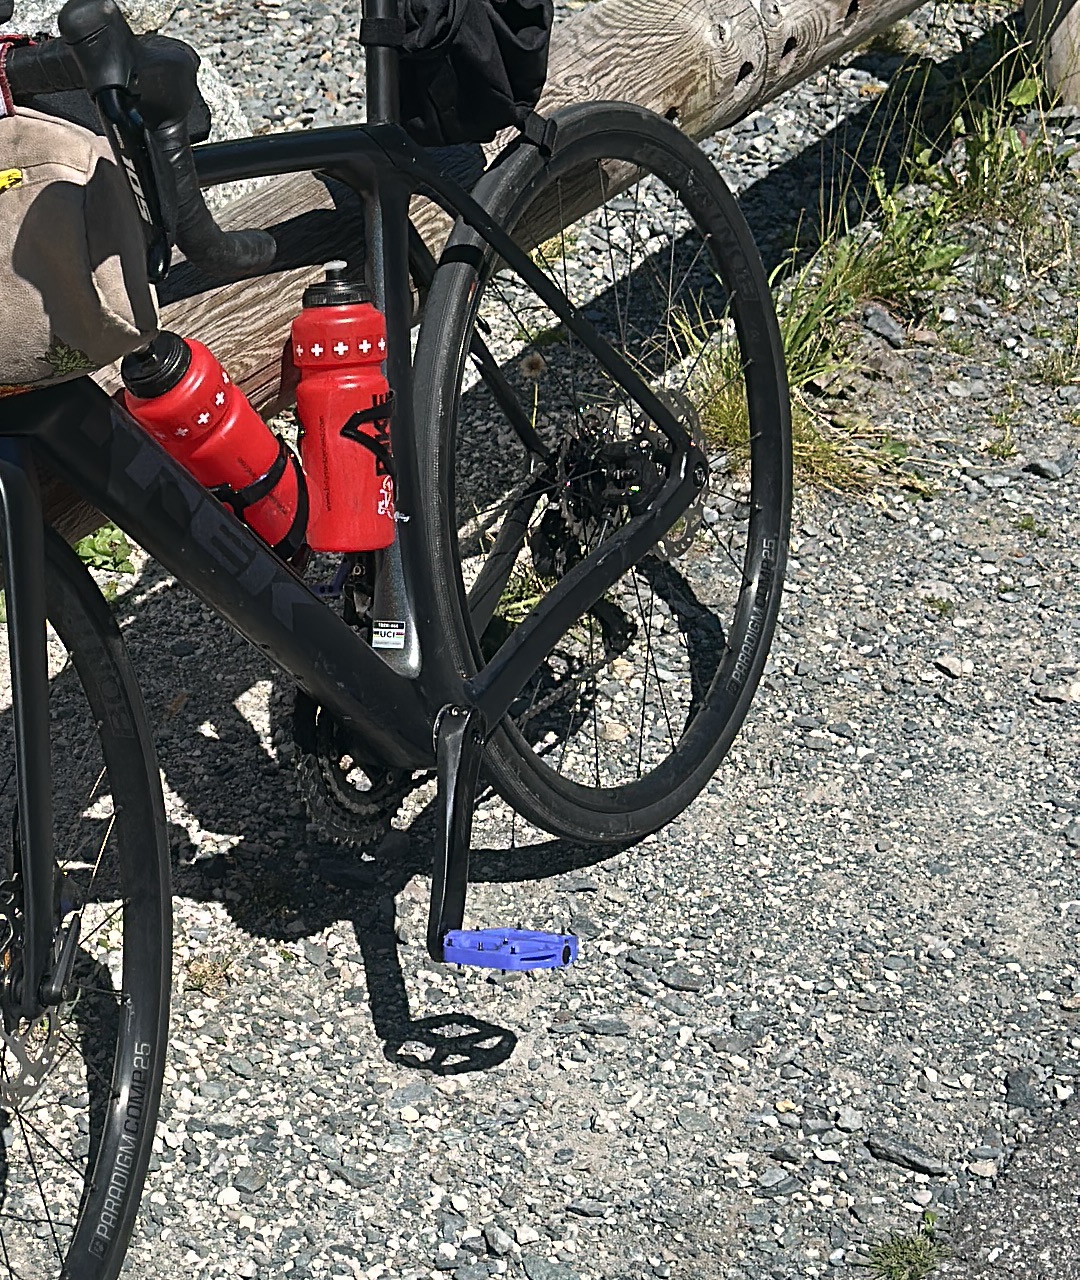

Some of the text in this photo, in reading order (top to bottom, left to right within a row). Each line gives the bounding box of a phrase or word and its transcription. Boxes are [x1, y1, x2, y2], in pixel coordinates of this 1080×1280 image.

[120, 154, 153, 226] 105
[380, 630, 396, 639] UCI
[731, 606, 764, 685] PARADIGM
[96, 1042, 151, 1241] PARADIGM COMP 25
